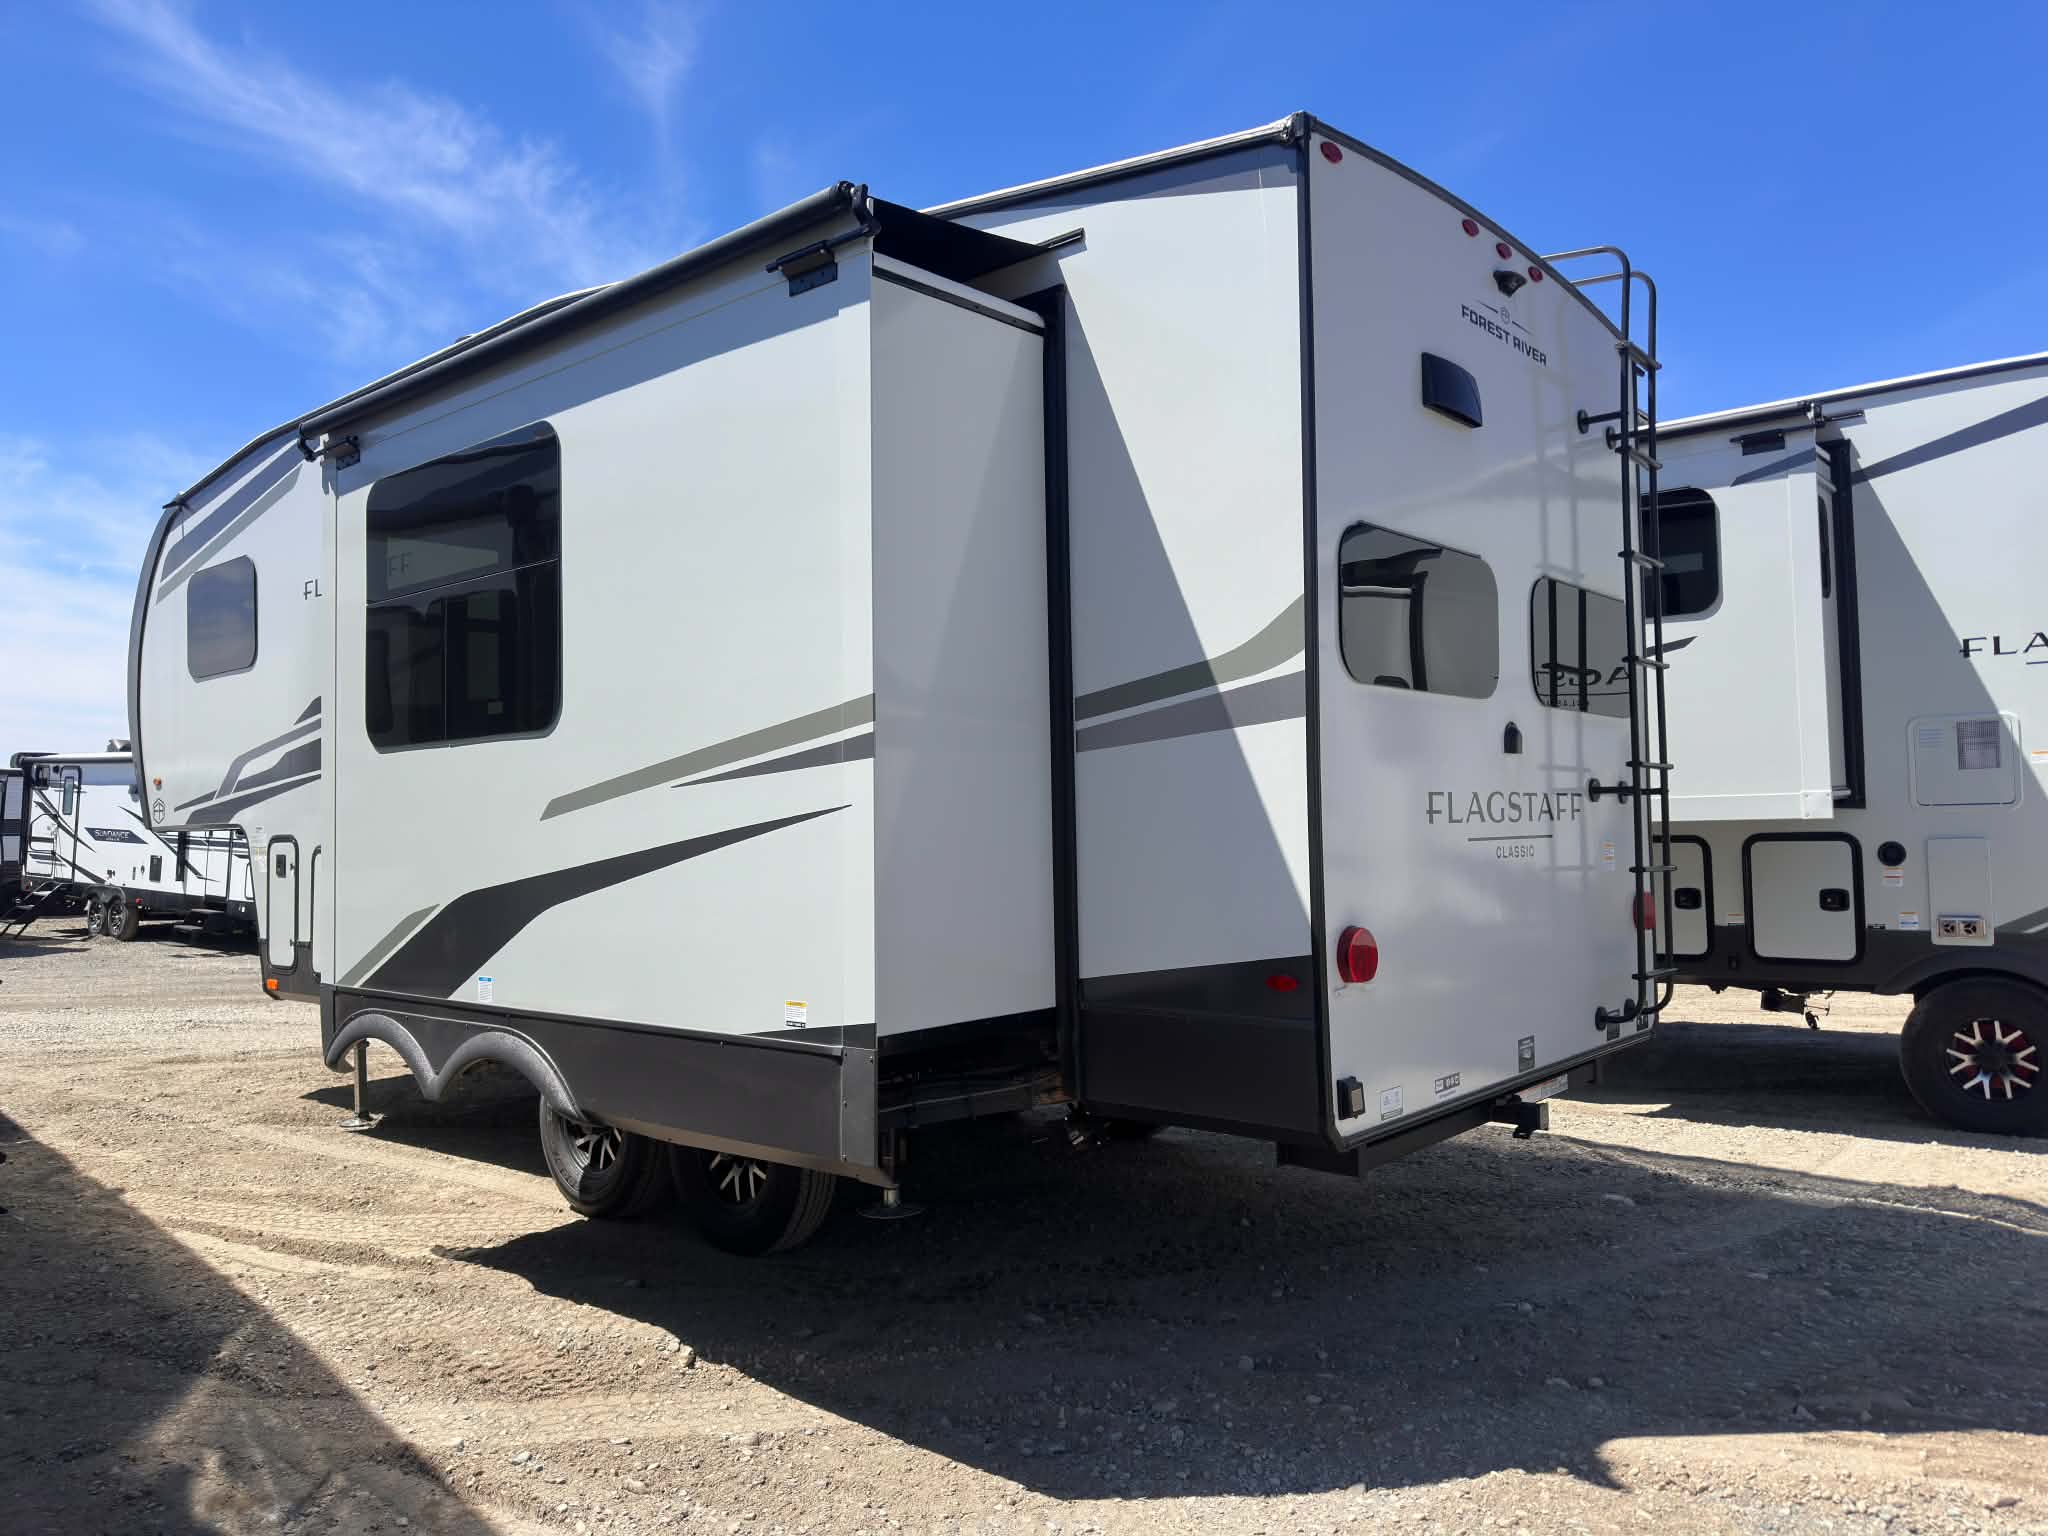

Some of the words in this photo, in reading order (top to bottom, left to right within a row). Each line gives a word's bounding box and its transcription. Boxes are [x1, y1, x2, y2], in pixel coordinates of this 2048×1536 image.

[1461, 304, 1510, 345] FOREST
[1513, 336, 1547, 366] RIVER
[303, 578, 322, 601] FL
[1959, 631, 2048, 658] FLA
[1425, 790, 1583, 825] FLAGSTAFF
[1495, 844, 1535, 859] CLASSIC
